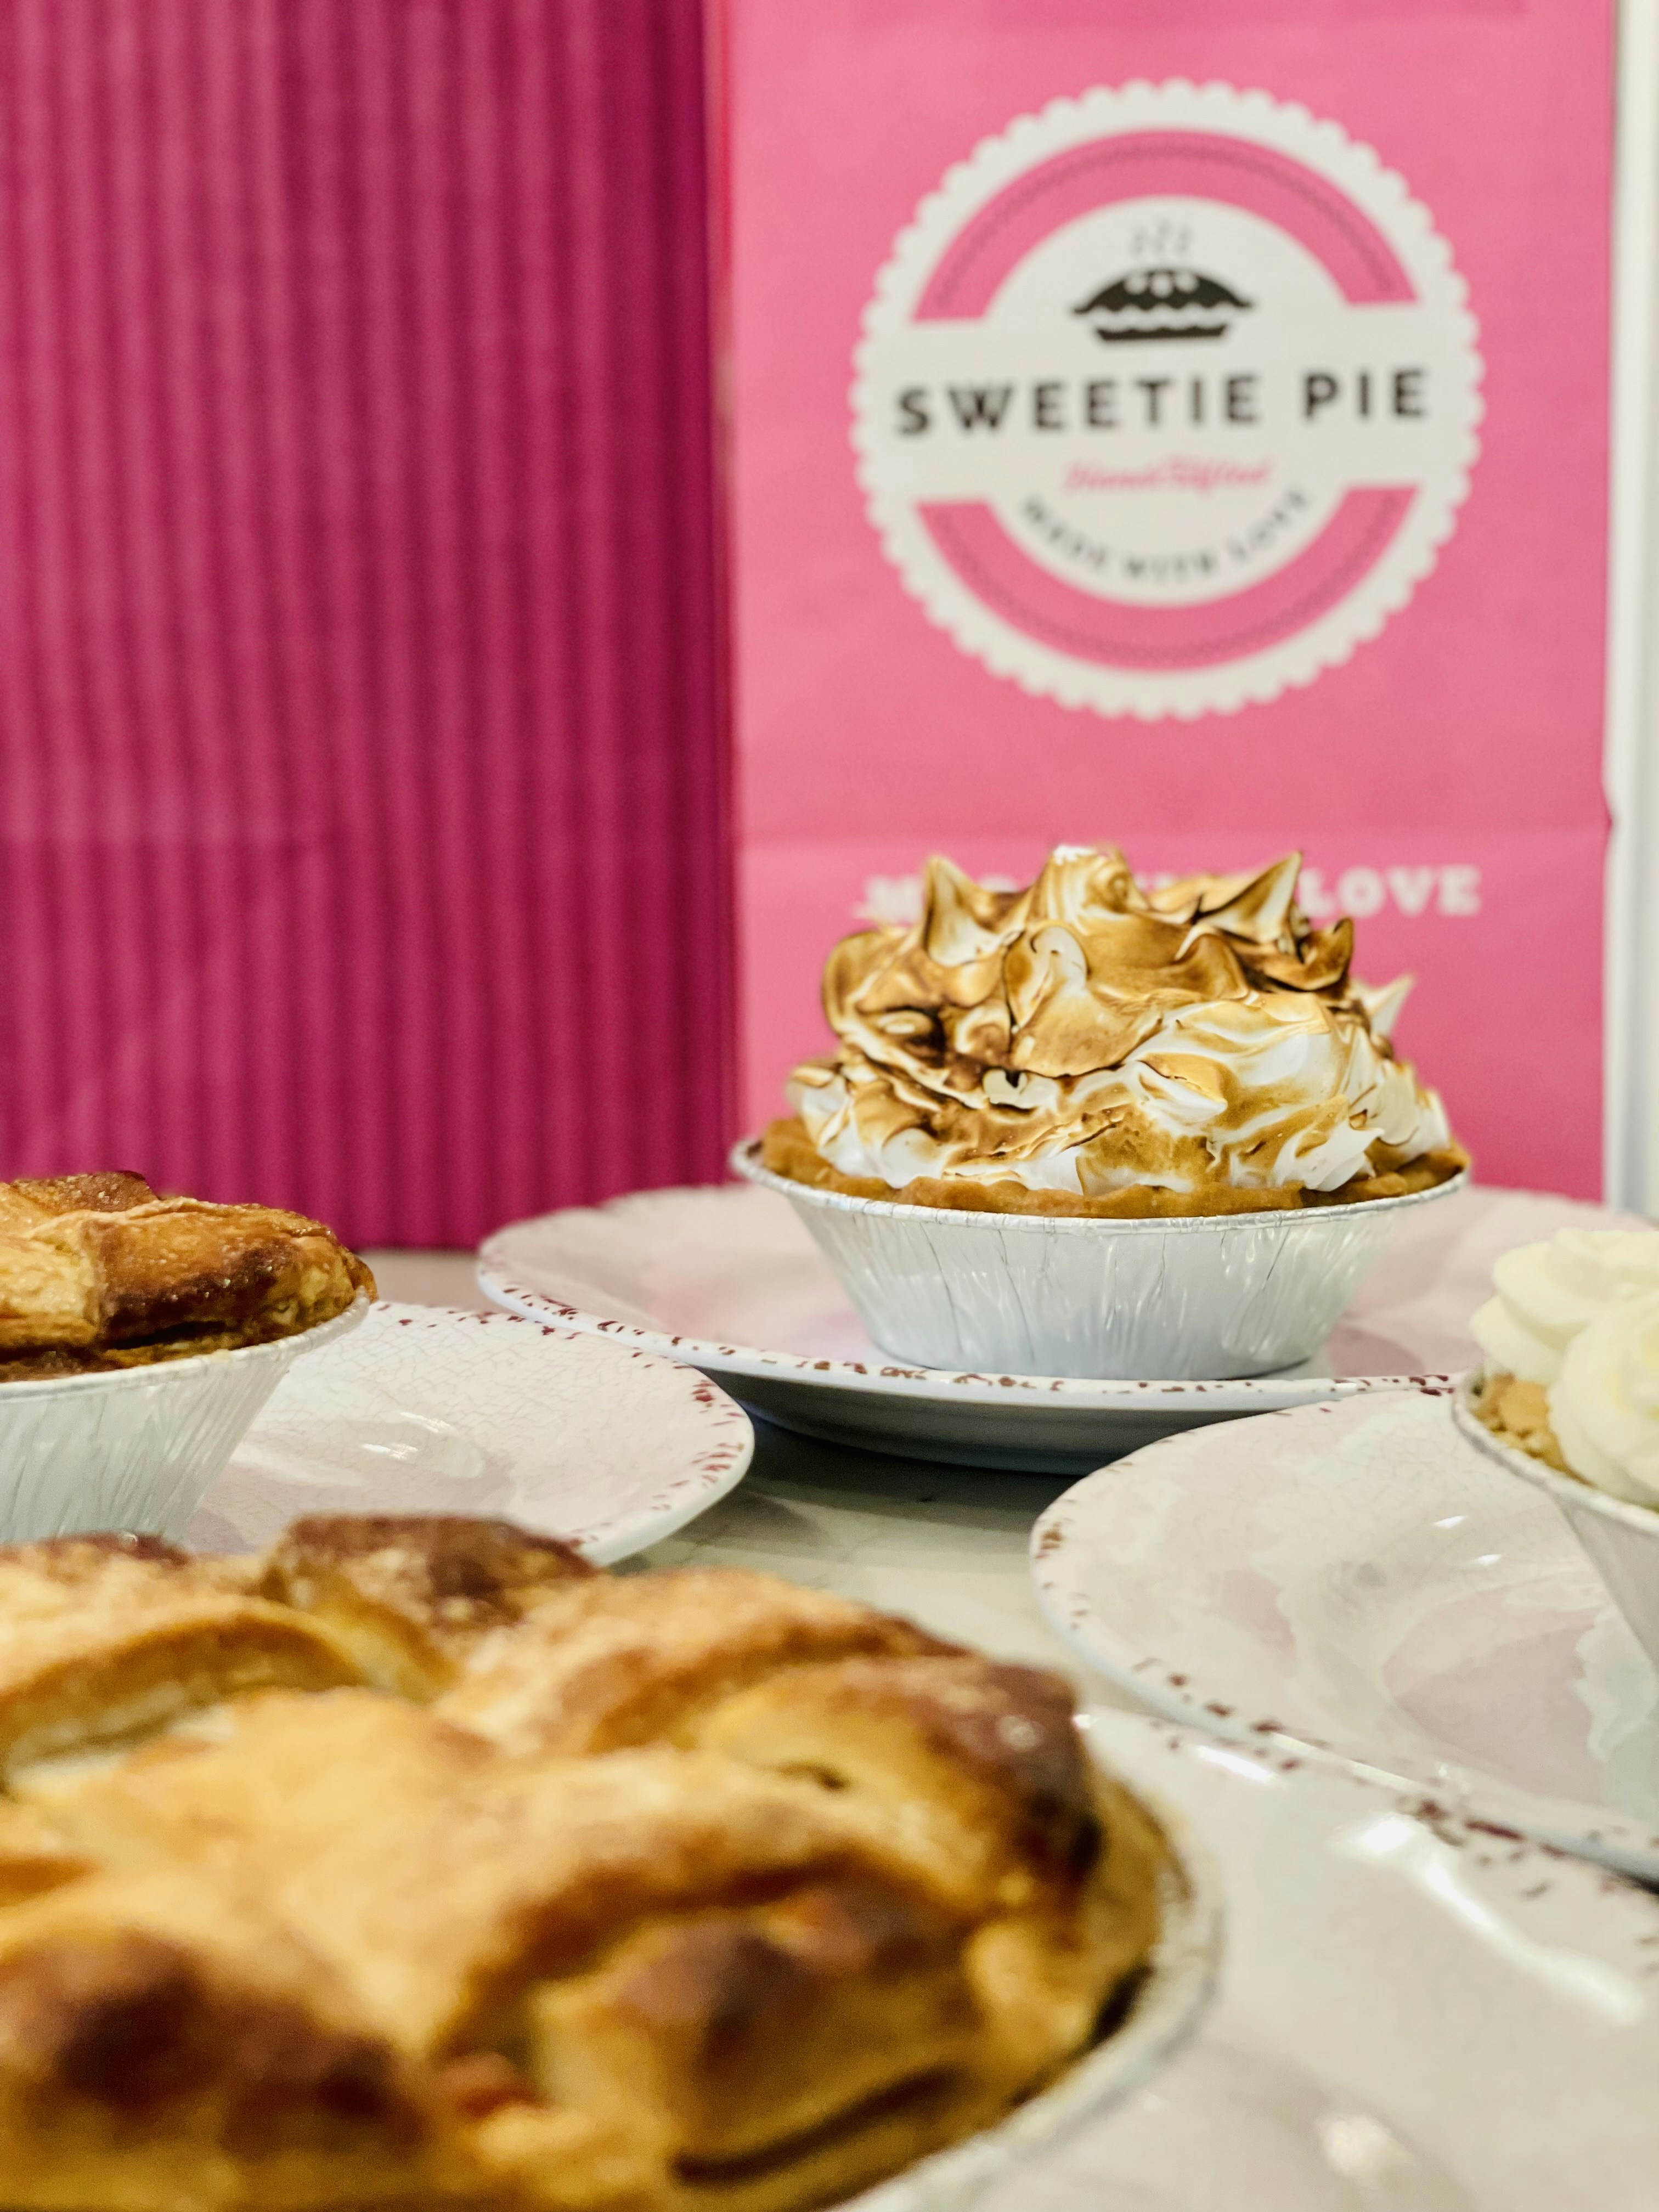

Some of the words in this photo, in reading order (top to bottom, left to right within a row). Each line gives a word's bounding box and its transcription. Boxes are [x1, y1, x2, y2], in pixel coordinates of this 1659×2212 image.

[895, 373, 1260, 437] SWEETIE
[1301, 365, 1427, 420] PIE
[1297, 865, 1481, 917] LOVE
